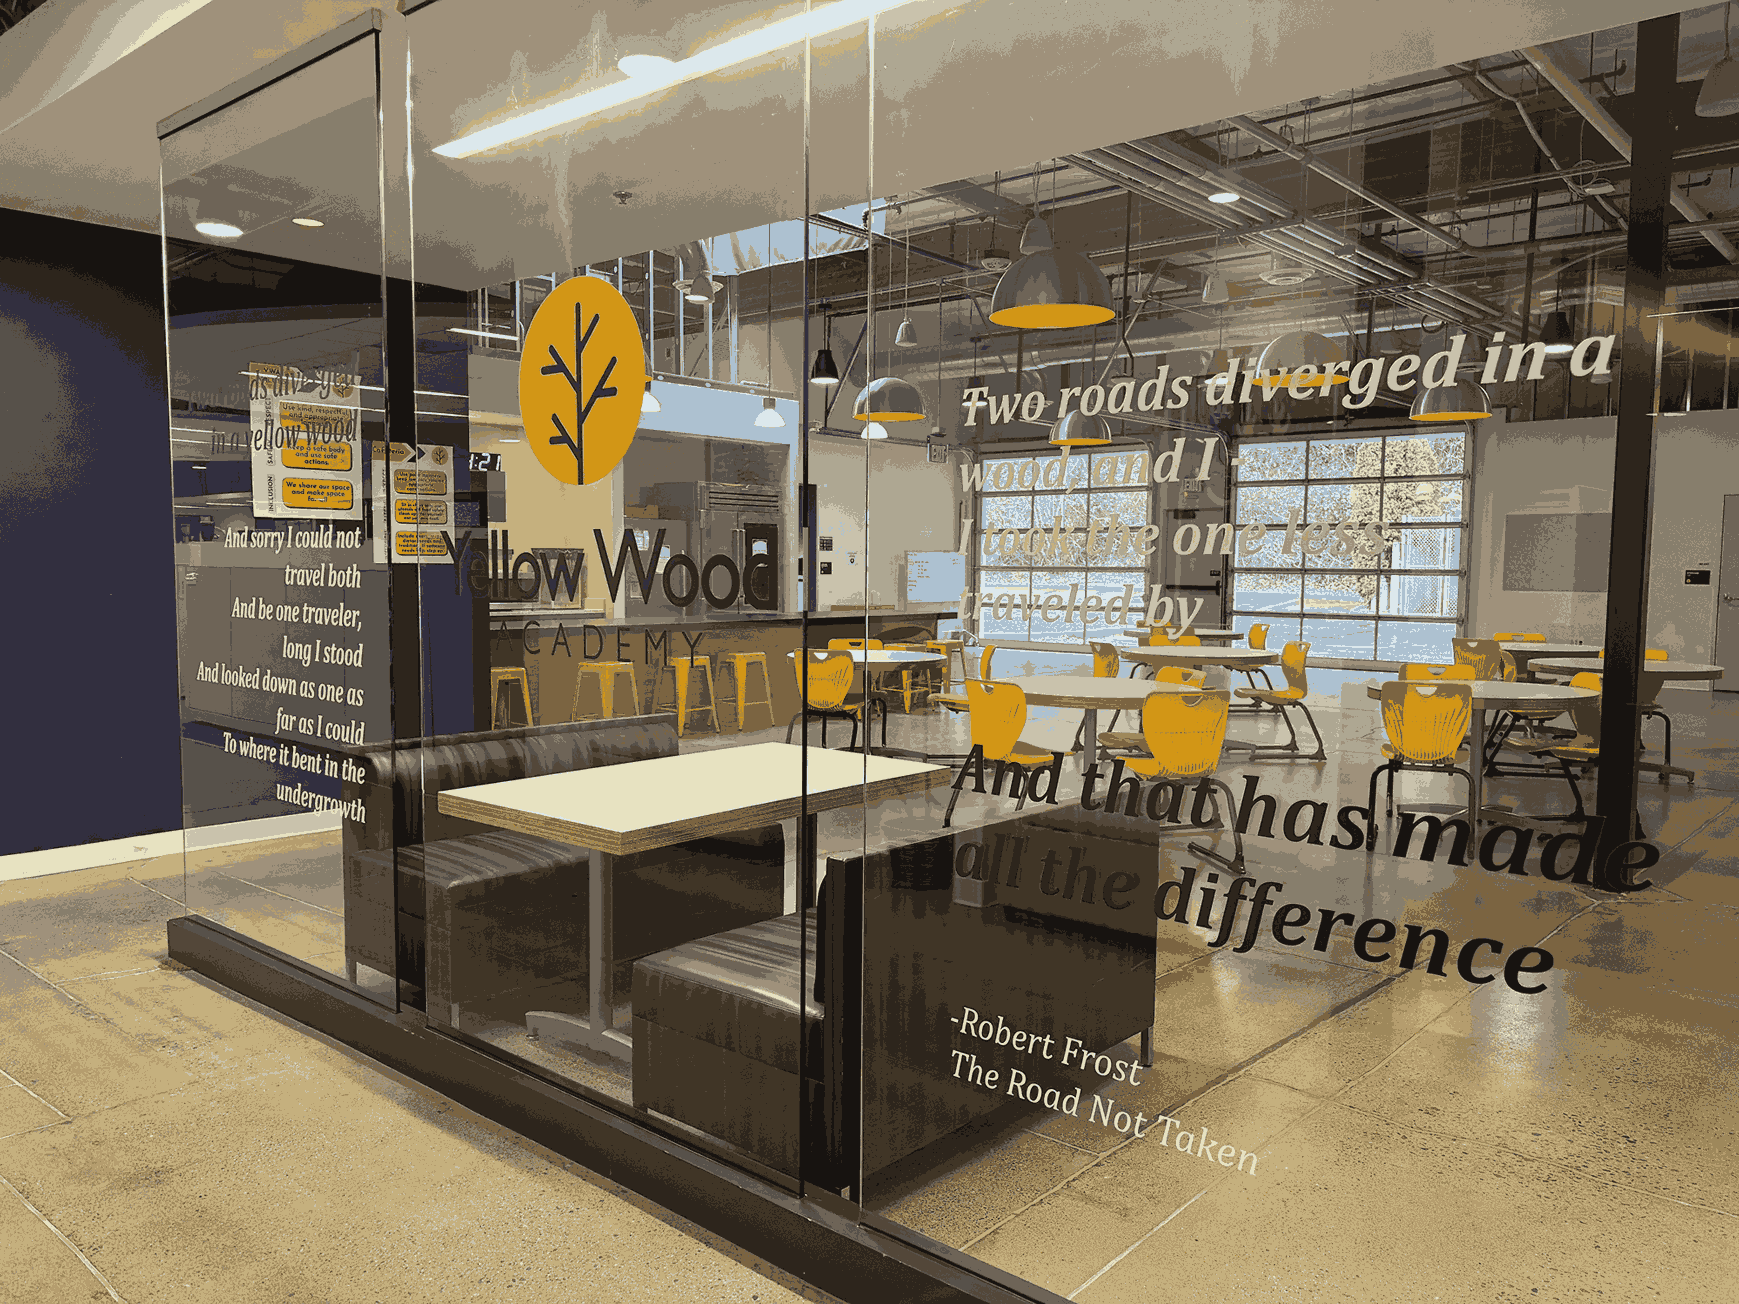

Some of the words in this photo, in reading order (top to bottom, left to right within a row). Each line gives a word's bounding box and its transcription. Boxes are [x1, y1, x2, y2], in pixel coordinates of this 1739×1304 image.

[962, 384, 1045, 428] Two
[1059, 366, 1190, 418] roads
[1205, 335, 1462, 410] diverged
[1481, 331, 1545, 385] in
[1570, 336, 1615, 378] a
[305, 408, 357, 446] wood
[329, 446, 346, 454] body
[295, 450, 309, 458] and
[469, 452, 501, 472] 1:21
[958, 445, 1078, 497] wood,
[1093, 437, 1184, 488] and
[1195, 438, 1218, 482] I
[299, 481, 318, 489] share
[224, 526, 247, 549] And
[251, 531, 284, 554] sorry
[285, 526, 293, 548] I
[295, 525, 333, 549] could
[336, 526, 361, 549] not
[957, 518, 975, 557] I
[983, 513, 1076, 558] took
[1085, 513, 1157, 558] the
[1172, 516, 1266, 558] one
[1281, 505, 1390, 556] less
[285, 563, 325, 587] travel
[328, 562, 361, 589] both
[440, 529, 585, 602] Yellow
[593, 528, 775, 610] Wood
[232, 597, 256, 619] And
[258, 597, 273, 621] be
[276, 606, 299, 623] one
[302, 602, 362, 632] traveler,
[956, 582, 1132, 627] traveled
[1143, 583, 1204, 640] by
[282, 635, 312, 668] long
[314, 639, 322, 662] I
[323, 643, 364, 668] stood
[496, 620, 704, 669] ACADEMY
[196, 661, 219, 684] And
[221, 662, 260, 690] looked
[262, 669, 297, 697] down
[299, 681, 315, 699] as
[318, 683, 344, 704] one
[346, 687, 364, 707] as
[275, 707, 296, 735] far
[298, 717, 314, 735] as
[316, 715, 324, 738] I
[325, 715, 365, 746] could
[223, 731, 237, 754] To
[239, 735, 277, 764] where
[279, 741, 290, 766] it
[292, 743, 322, 774] bent
[324, 753, 338, 778] in
[341, 757, 366, 785] the
[276, 782, 366, 824] undergrowth
[951, 744, 1061, 806] And
[1080, 760, 1223, 830] that
[1235, 775, 1374, 851] has
[1393, 811, 1661, 893] made
[953, 835, 1030, 890] all
[1040, 843, 1142, 911] the
[1153, 866, 1556, 995] difference
[950, 1006, 1055, 1059] -Robert
[1061, 1036, 1143, 1087] Frost
[951, 1049, 1001, 1092] The
[1006, 1069, 1081, 1118] Road
[1089, 1094, 1148, 1140] Not
[1157, 1114, 1260, 1177] Taken
